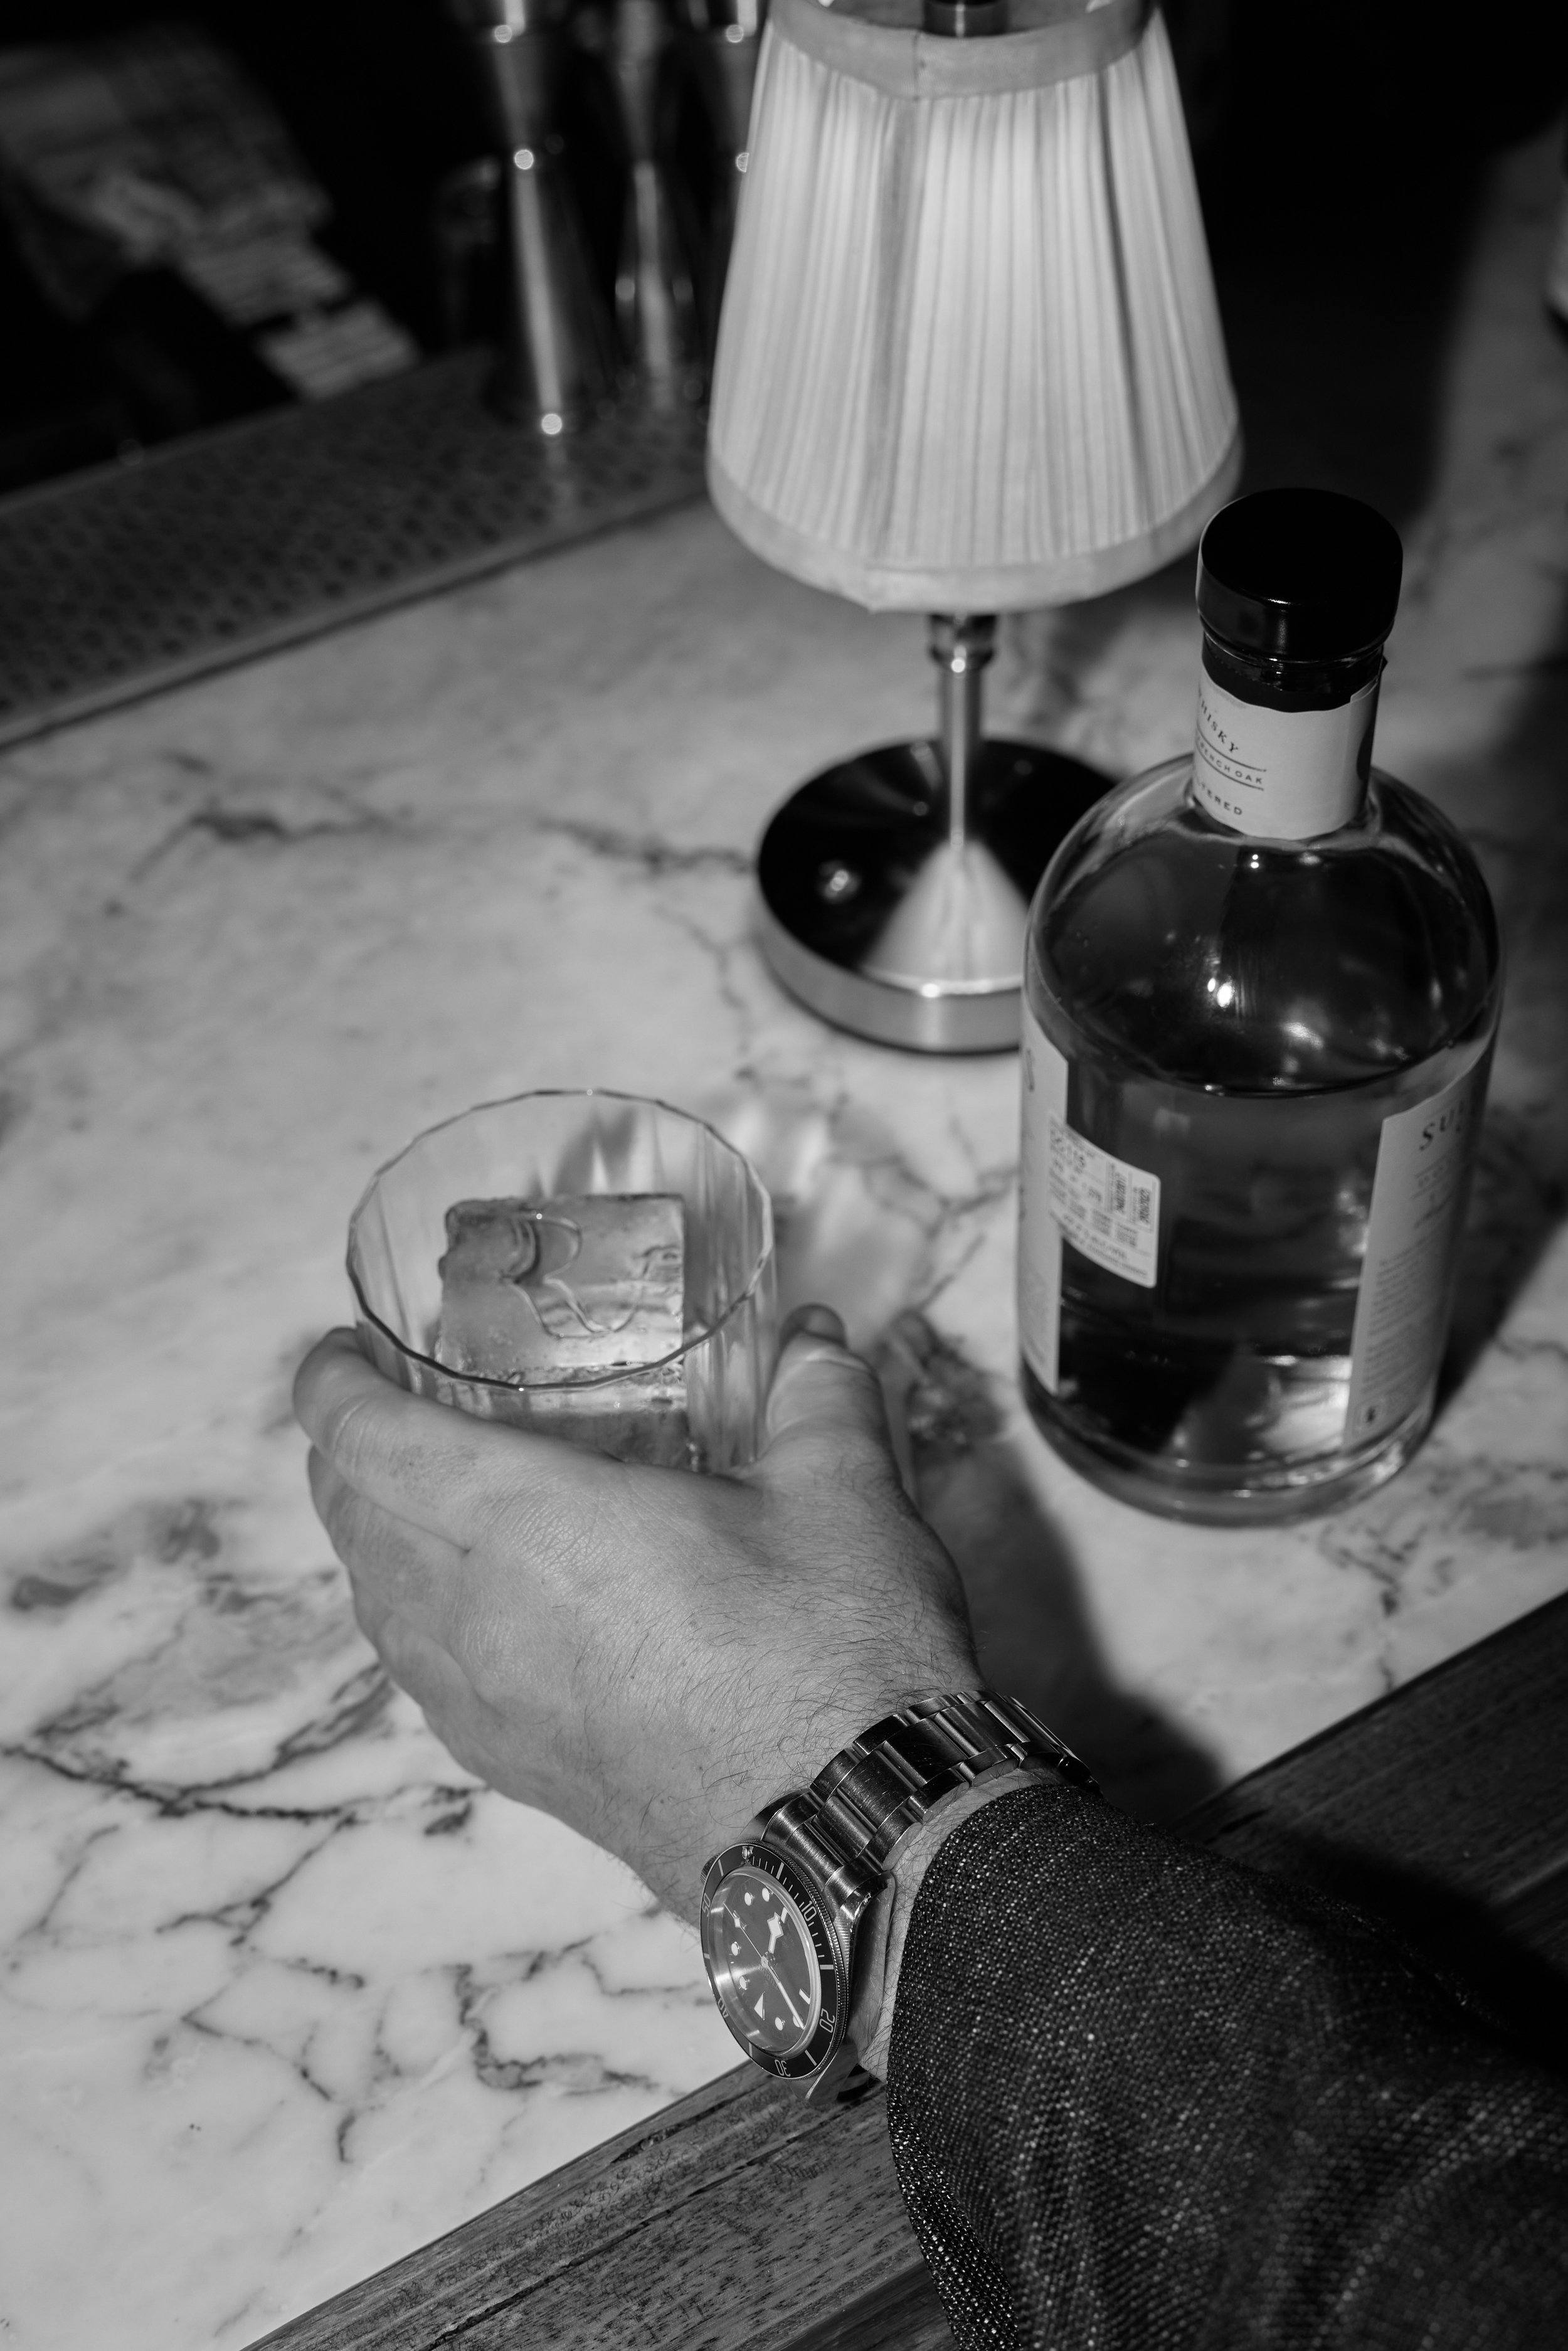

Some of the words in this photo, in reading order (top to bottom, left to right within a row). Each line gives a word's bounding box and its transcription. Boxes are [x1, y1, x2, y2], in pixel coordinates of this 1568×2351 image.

[1234, 769, 1263, 785] OAK
[702, 1892, 711, 1918] 50
[801, 1900, 817, 1922] 10
[718, 1997, 729, 2019] 40
[819, 2008, 835, 2034] 20
[775, 2059, 791, 2076] 30
